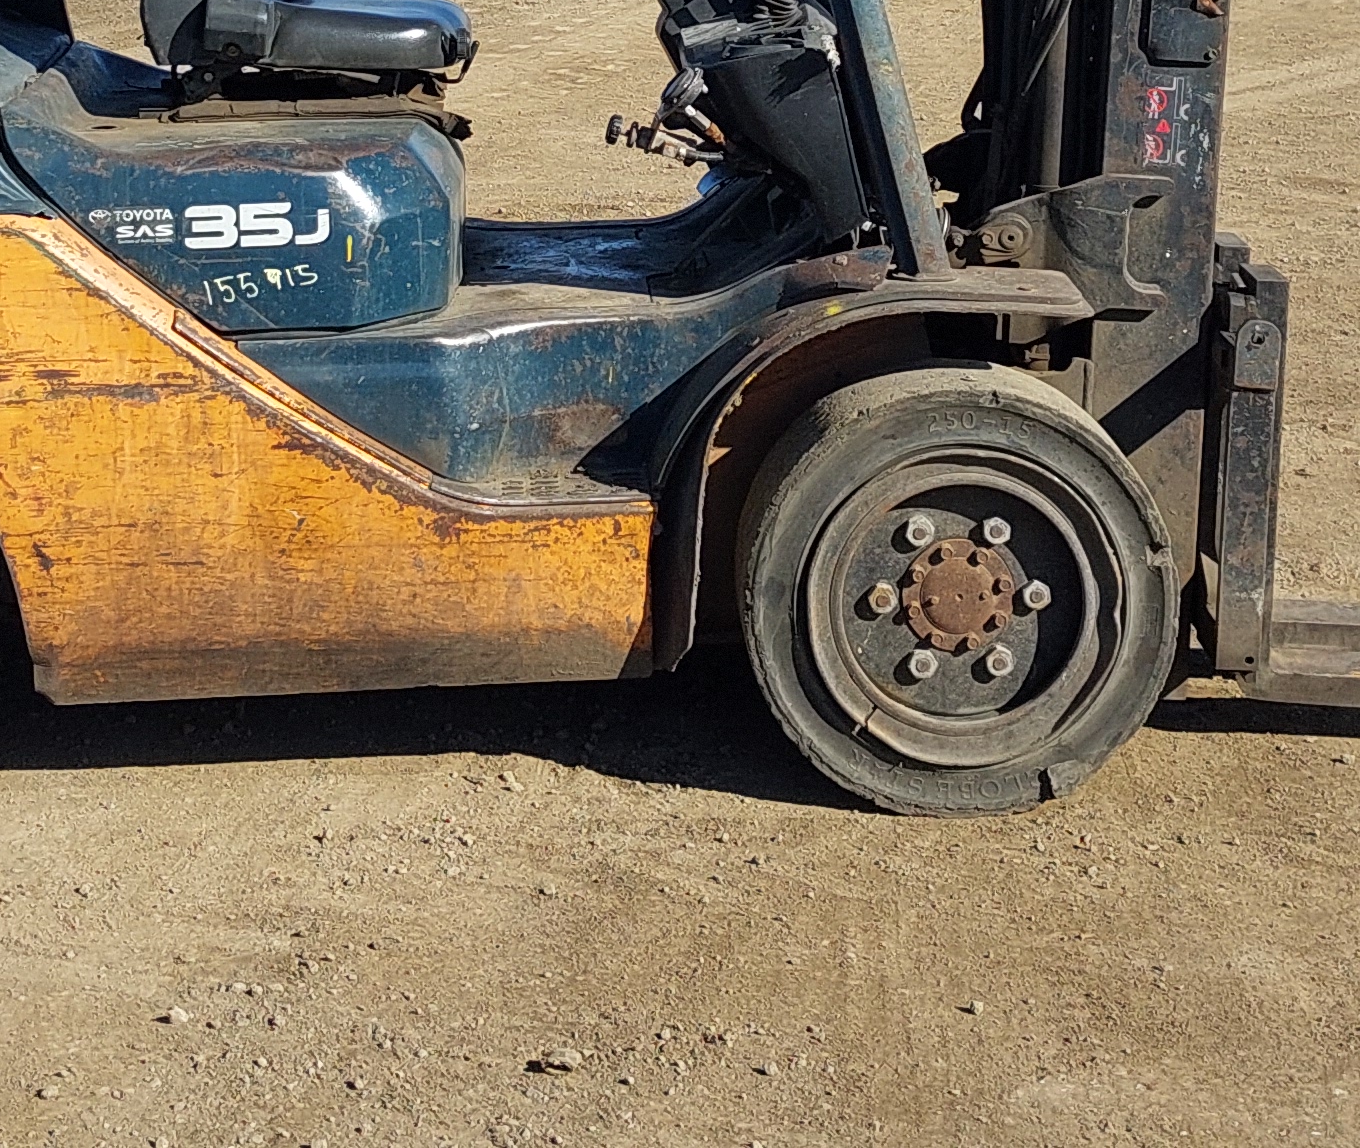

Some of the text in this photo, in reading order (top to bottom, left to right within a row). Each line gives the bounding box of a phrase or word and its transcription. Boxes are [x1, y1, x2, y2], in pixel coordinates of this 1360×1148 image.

[112, 208, 174, 222] TOYOTA
[115, 224, 174, 239] SAS
[184, 202, 331, 250] 35J
